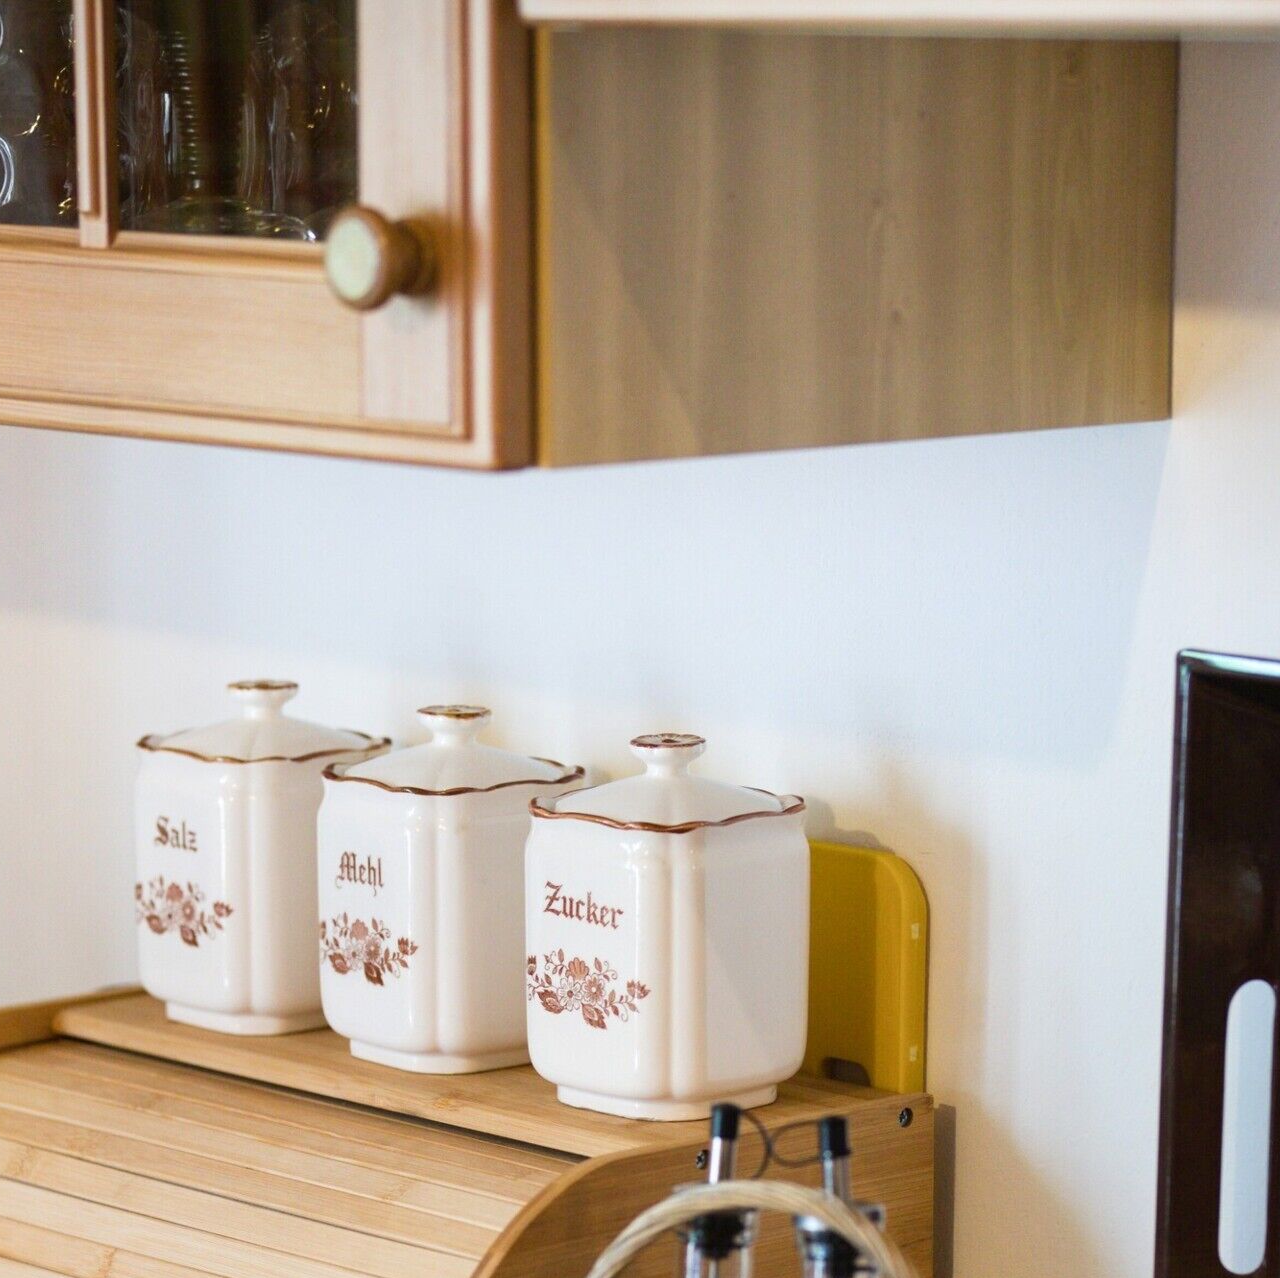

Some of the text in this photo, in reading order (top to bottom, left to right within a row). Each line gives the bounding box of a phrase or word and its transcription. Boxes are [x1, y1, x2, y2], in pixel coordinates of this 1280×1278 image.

[154, 815, 198, 852] Salz
[335, 851, 384, 897] Mehl
[543, 880, 624, 930] Zucker
